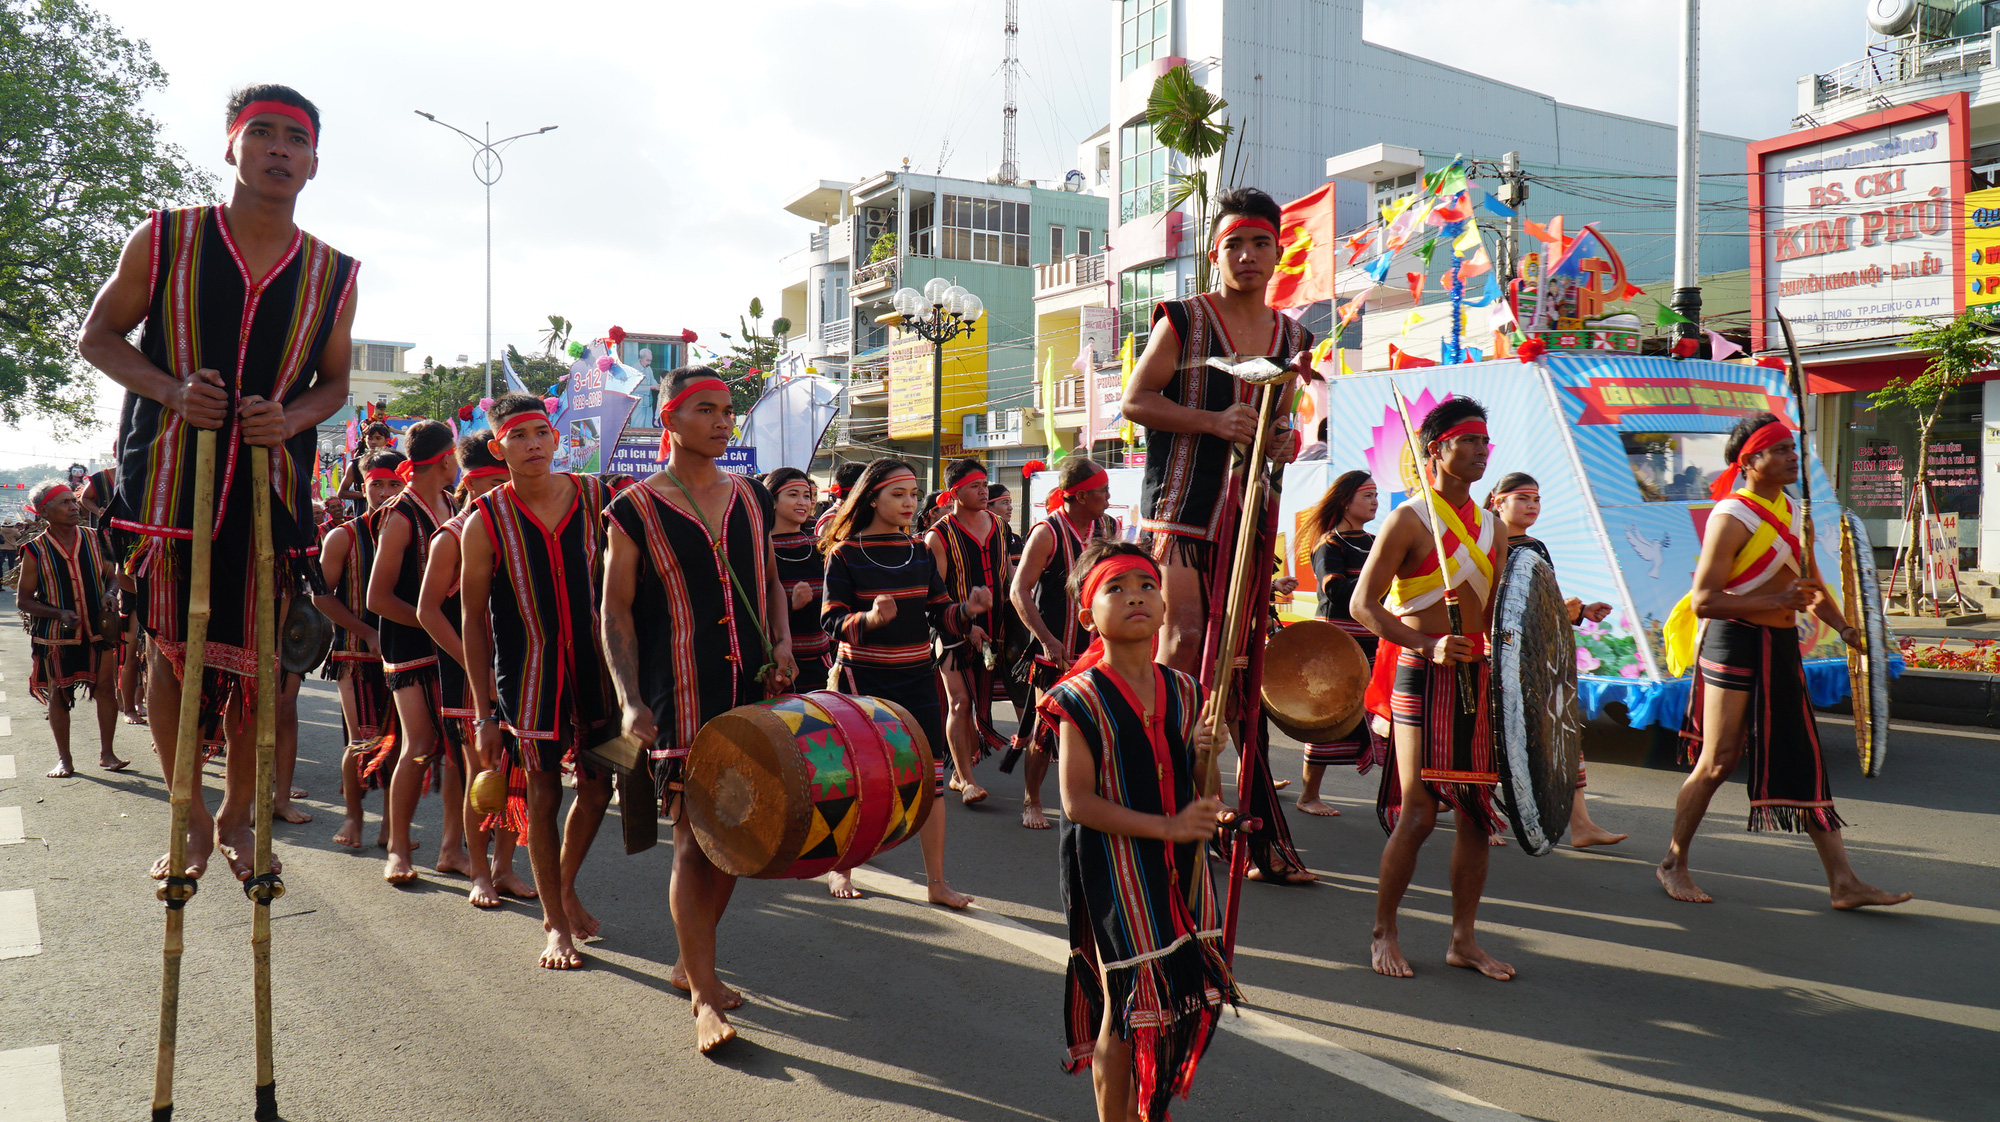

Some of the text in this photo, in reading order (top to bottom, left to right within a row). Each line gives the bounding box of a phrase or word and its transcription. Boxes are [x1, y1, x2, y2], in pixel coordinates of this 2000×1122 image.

[1823, 148, 1864, 170] KHÁM
[1864, 137, 1909, 164] NGOÀI
[1909, 130, 1939, 153] GIỜ
[1808, 168, 1906, 209] BS. CKI
[1773, 186, 1945, 262] KIM PHÚ
[1777, 273, 1823, 297] CHUYÊN
[1825, 270, 1858, 291] KHOA
[1859, 264, 1882, 287] NỘI
[1891, 263, 1909, 280] DA
[1911, 251, 1941, 277] LIỄU
[574, 367, 602, 392] 3-12
[573, 391, 602, 410] 1929-2019
[630, 448, 646, 459] ÍCH
[730, 450, 748, 461] CÂY
[1879, 445, 1898, 455] CKI
[617, 461, 634, 472] ÍCH
[635, 462, 662, 473] TRĂM
[1852, 460, 1876, 471] KIM
[1878, 455, 1904, 471] PHÚ
[1943, 516, 1956, 529] 44
